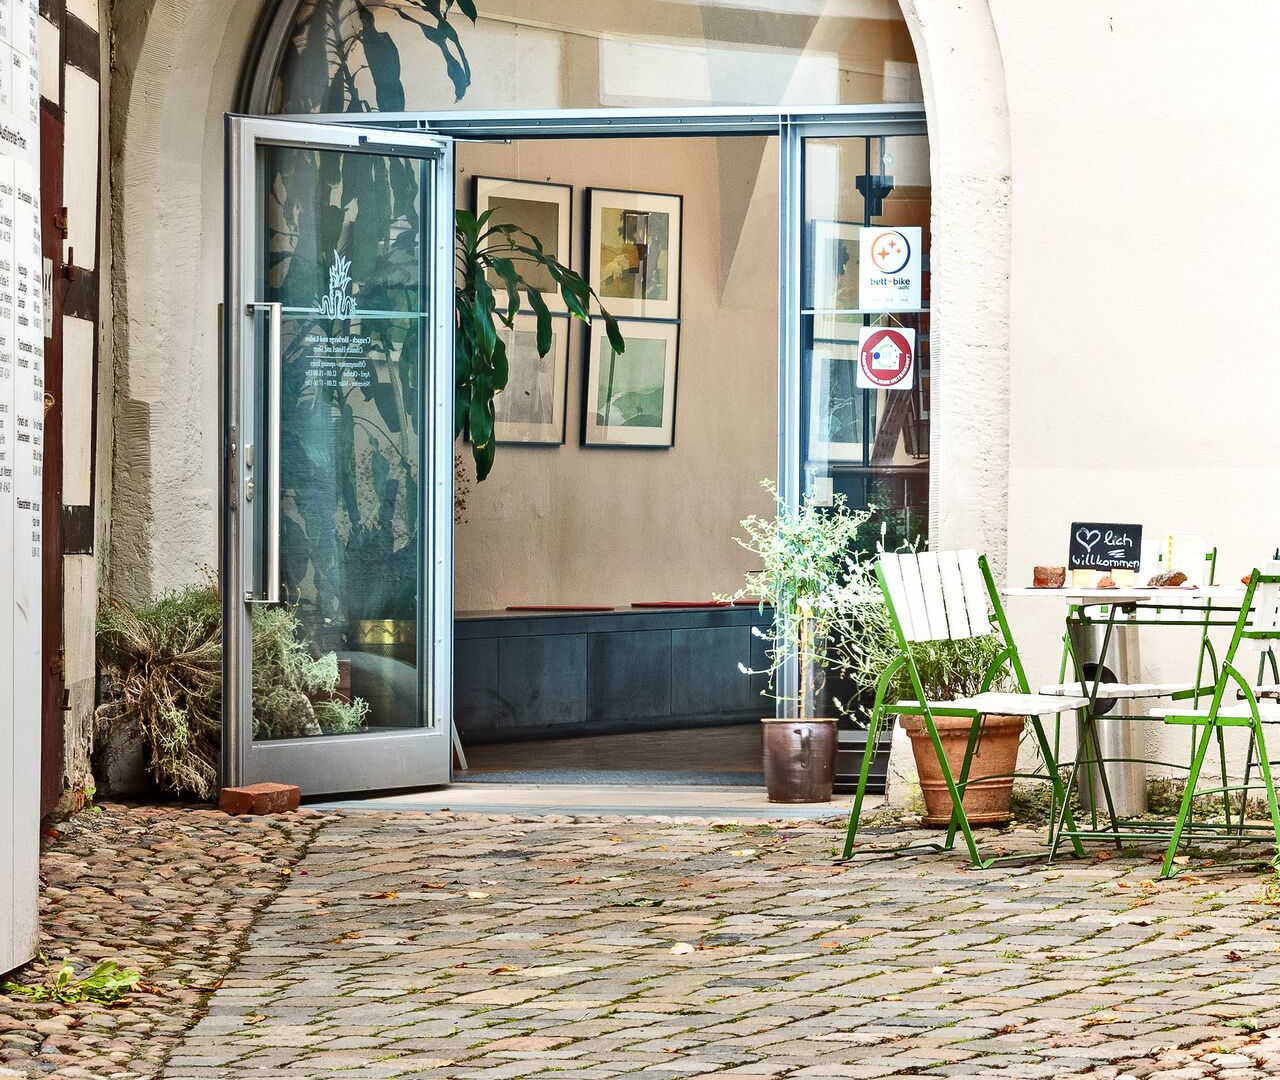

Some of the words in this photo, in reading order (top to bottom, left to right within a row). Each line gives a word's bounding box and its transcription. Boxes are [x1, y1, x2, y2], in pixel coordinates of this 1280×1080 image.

[893, 277, 910, 286] bike
[1104, 530, 1133, 547] lich
[1072, 553, 1140, 569] willkommen
